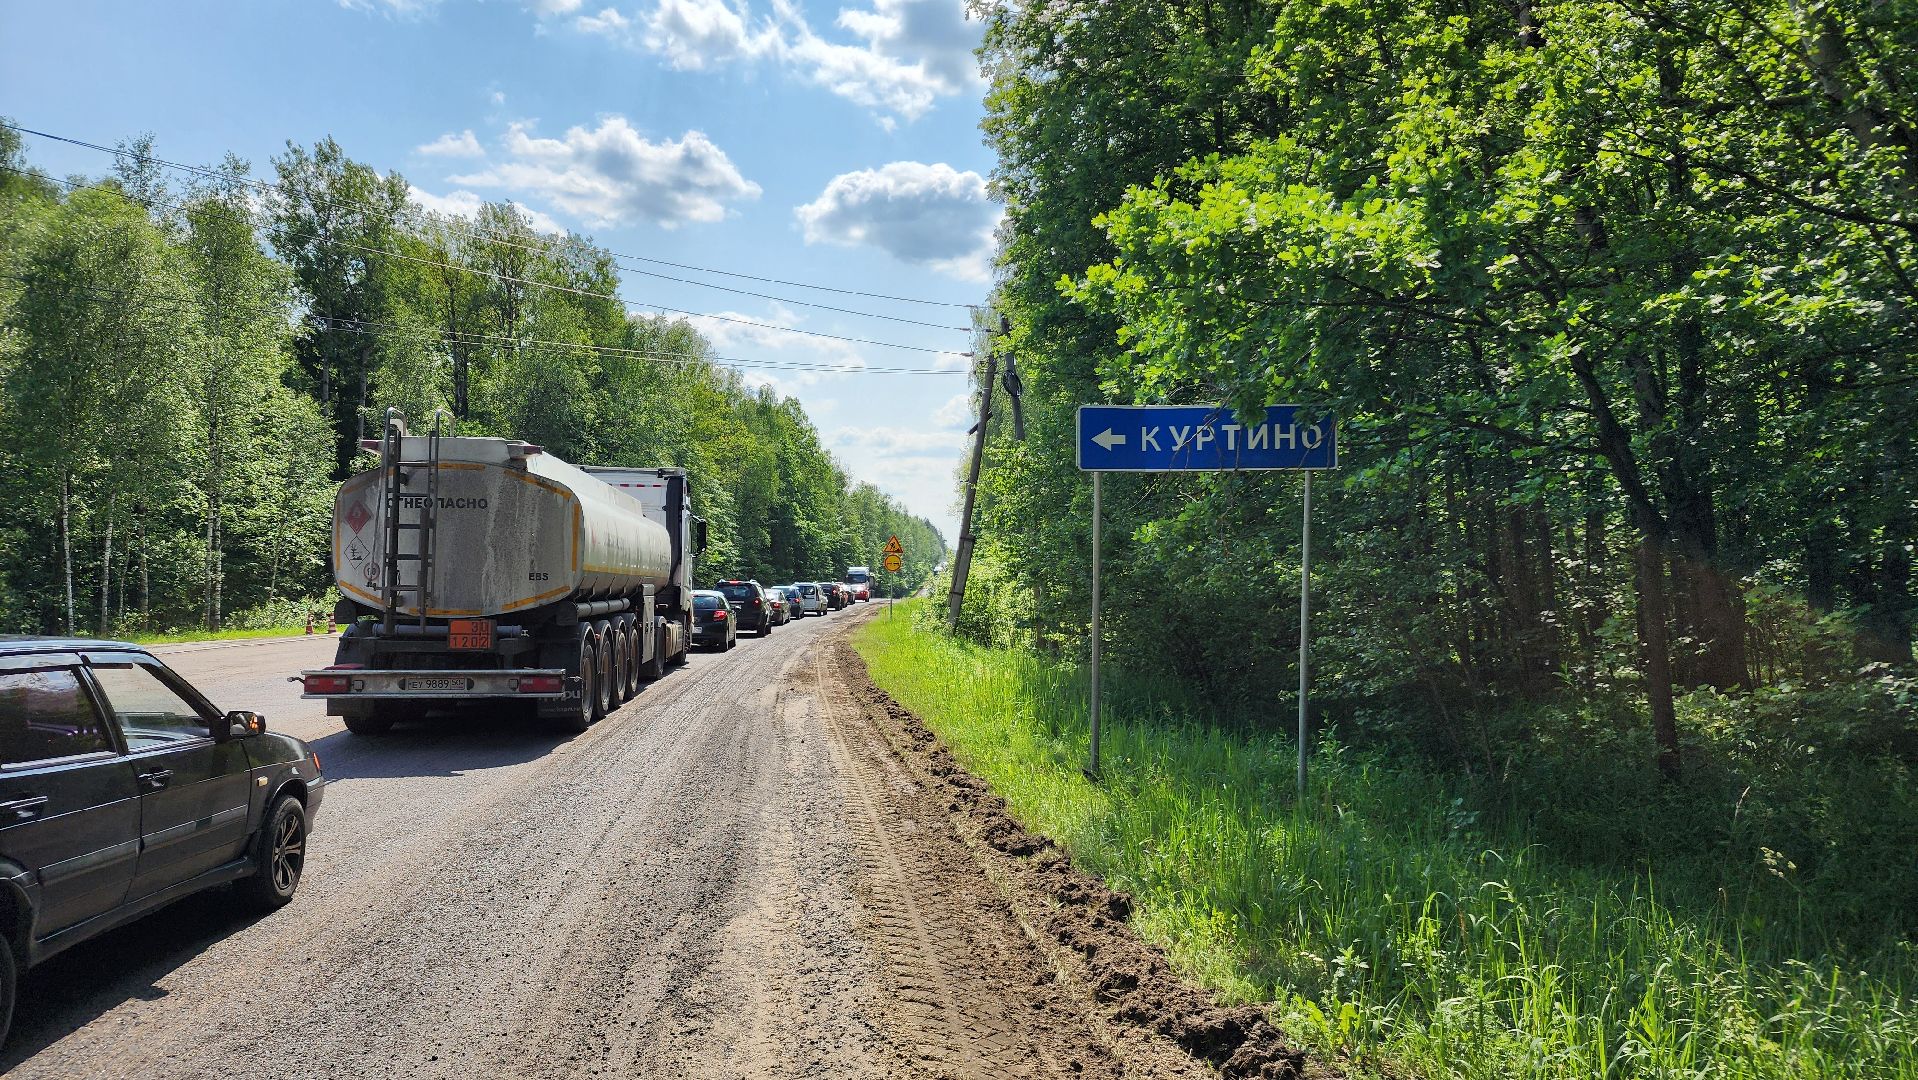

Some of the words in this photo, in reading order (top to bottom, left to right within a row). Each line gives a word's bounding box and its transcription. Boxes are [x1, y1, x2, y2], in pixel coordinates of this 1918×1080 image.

[1141, 423, 1322, 451] КУРТИНО
[529, 572, 549, 581] EBS
[471, 621, 488, 633] 30
[452, 636, 488, 648] 1202
[426, 679, 450, 689] 9889
